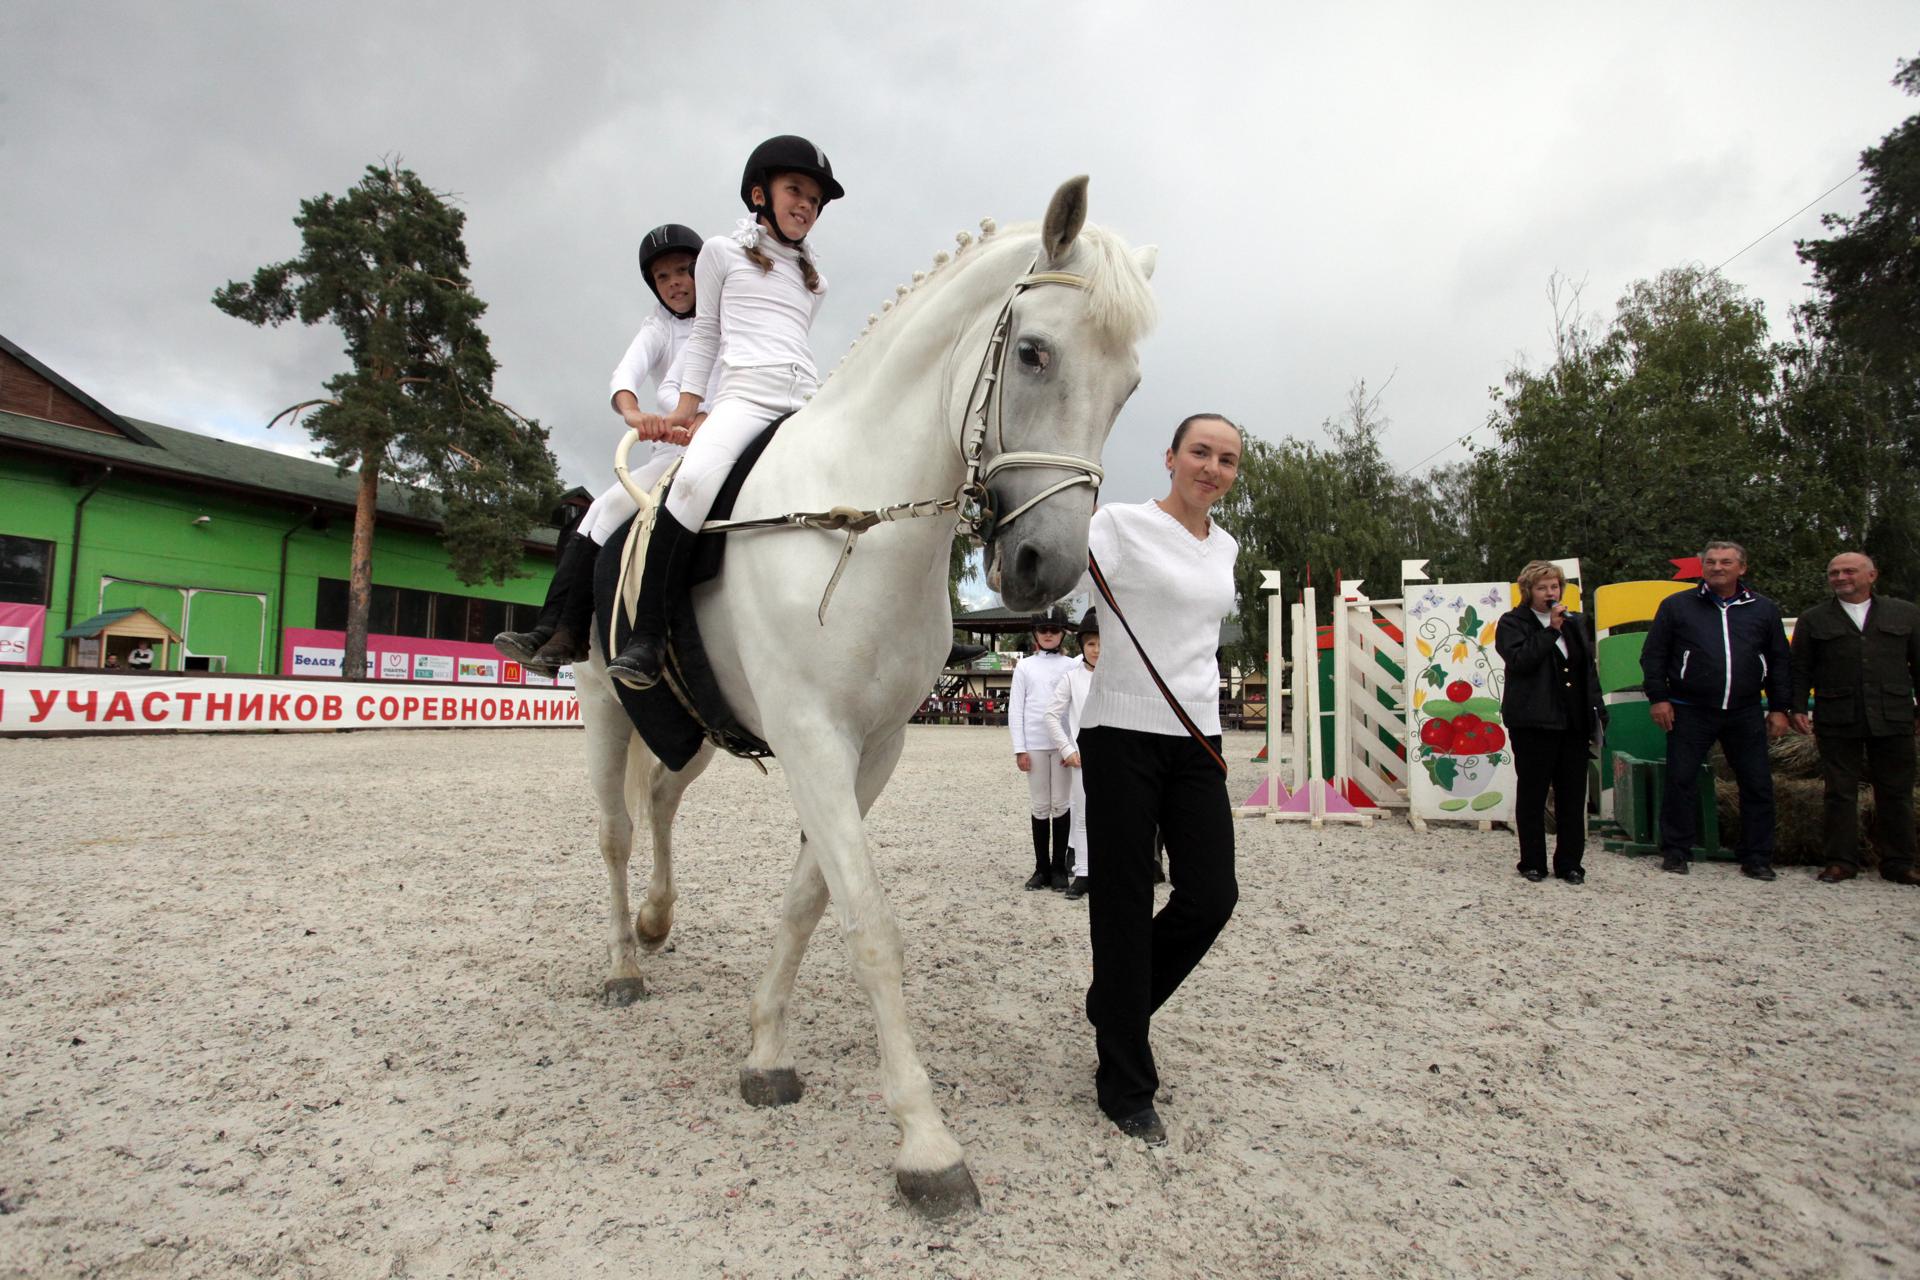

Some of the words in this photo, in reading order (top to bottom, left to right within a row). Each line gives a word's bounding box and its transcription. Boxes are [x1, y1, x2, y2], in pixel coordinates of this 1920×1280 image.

[295, 654, 337, 667] Белая
[565, 671, 576, 680] РБ
[30, 689, 343, 723] УЧАСТНИКОВ
[356, 695, 580, 721] СОРЕВНОВАНИЙ
